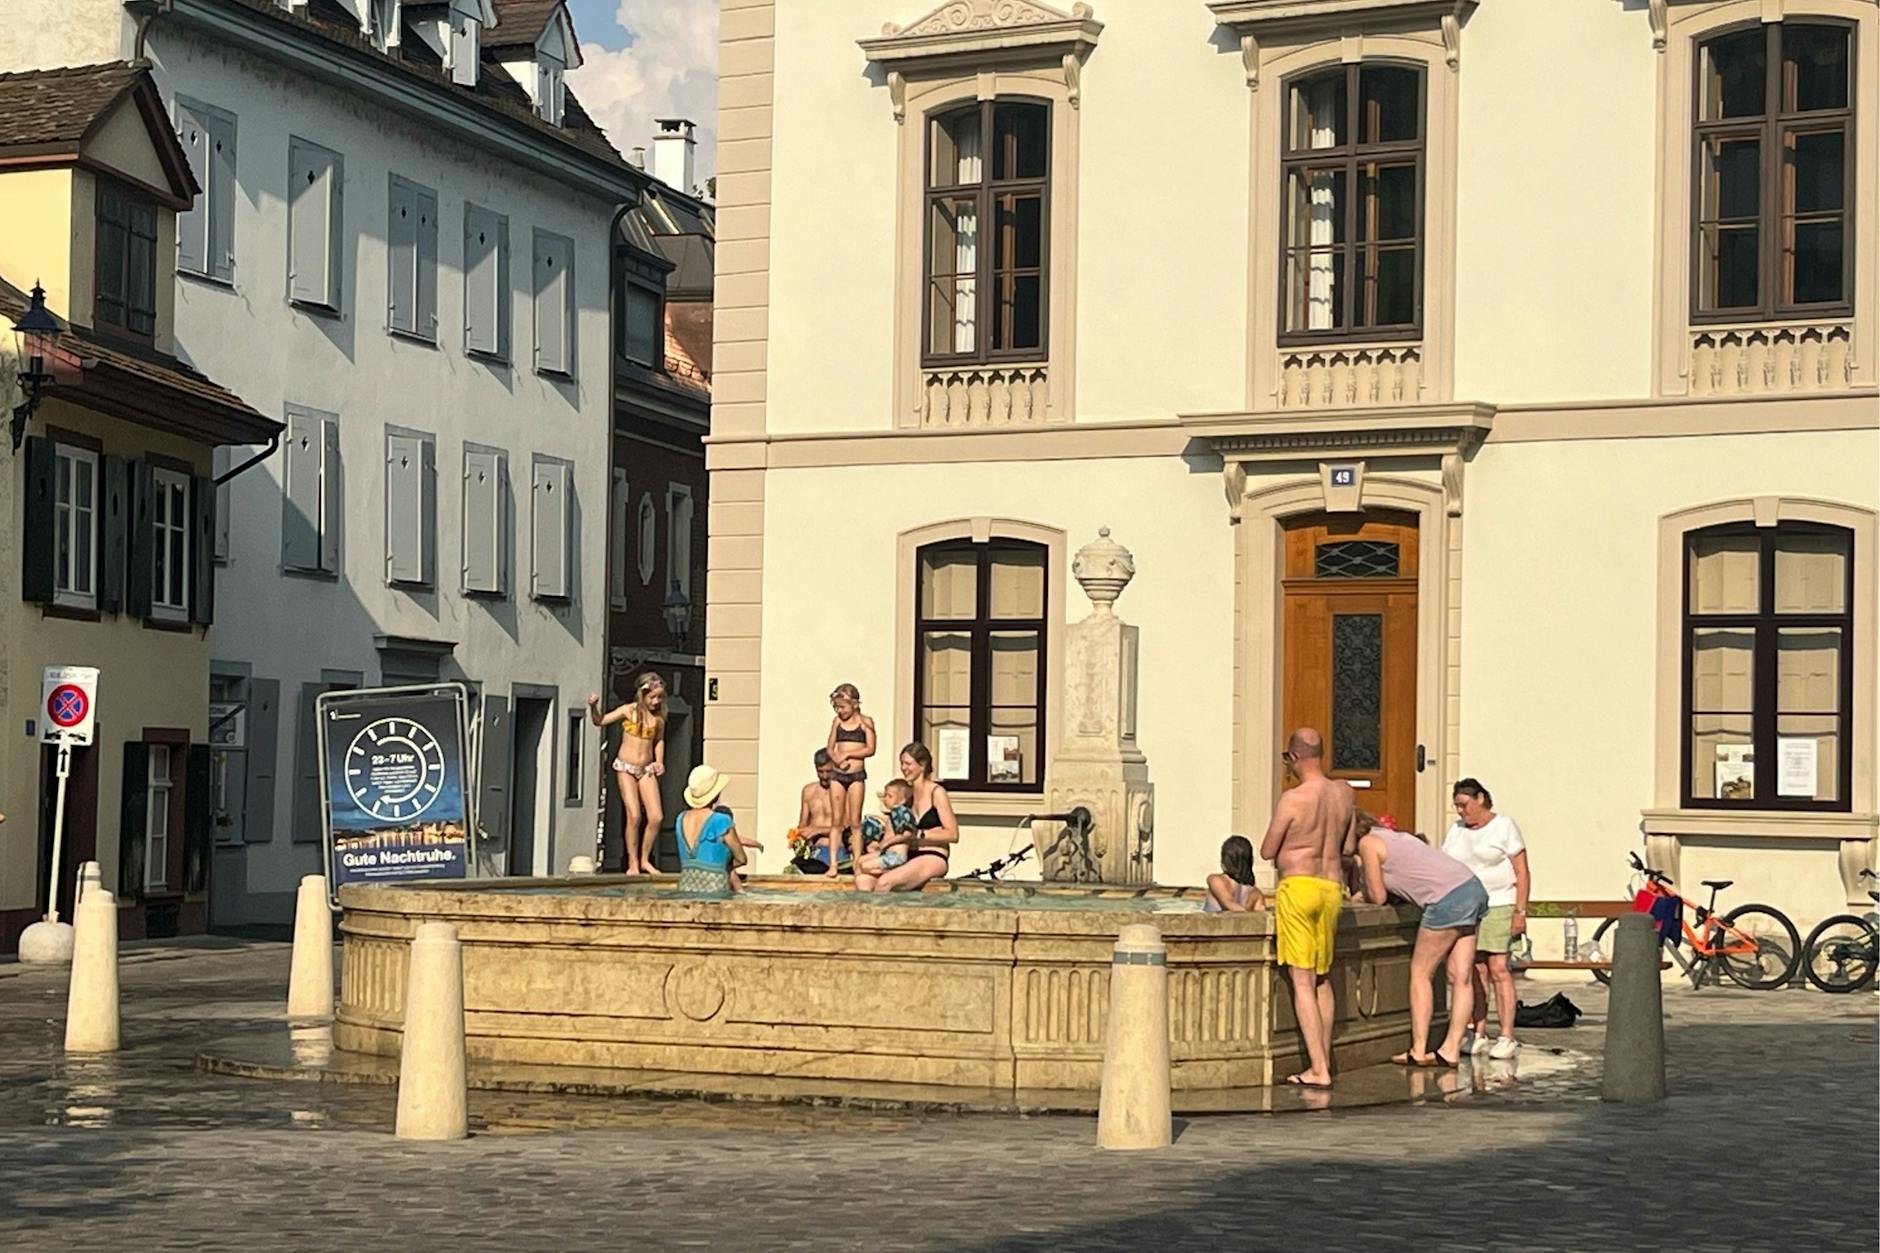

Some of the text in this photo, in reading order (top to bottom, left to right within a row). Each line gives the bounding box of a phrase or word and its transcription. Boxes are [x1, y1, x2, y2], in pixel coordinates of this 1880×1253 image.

[1335, 471, 1350, 483] 49
[396, 753, 415, 763] Uhr
[343, 848, 456, 866] Gute Nachtruhe.
